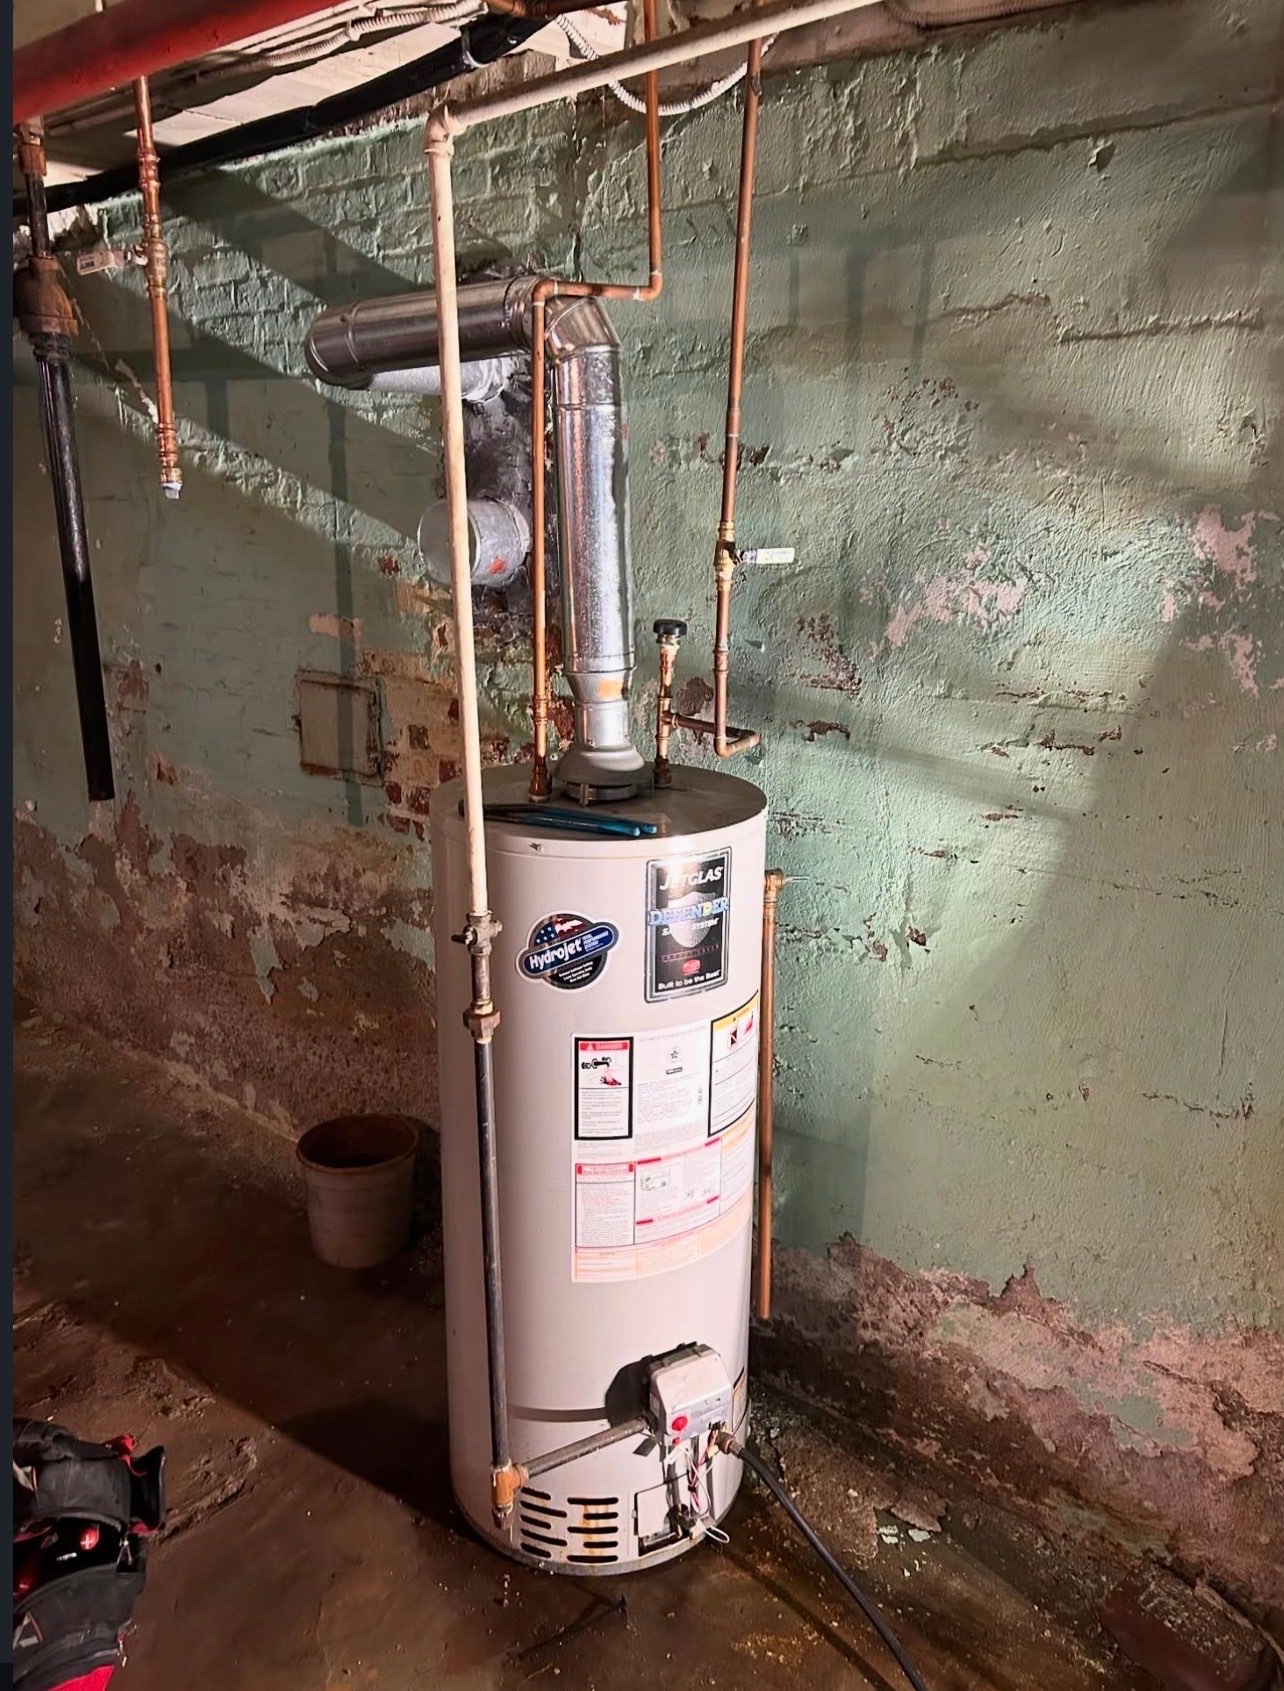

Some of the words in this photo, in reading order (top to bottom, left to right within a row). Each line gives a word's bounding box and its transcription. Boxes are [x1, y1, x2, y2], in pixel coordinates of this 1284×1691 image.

[659, 866, 724, 891] JTGLAS
[648, 896, 730, 926] DEFENDER
[675, 979, 683, 987] to
